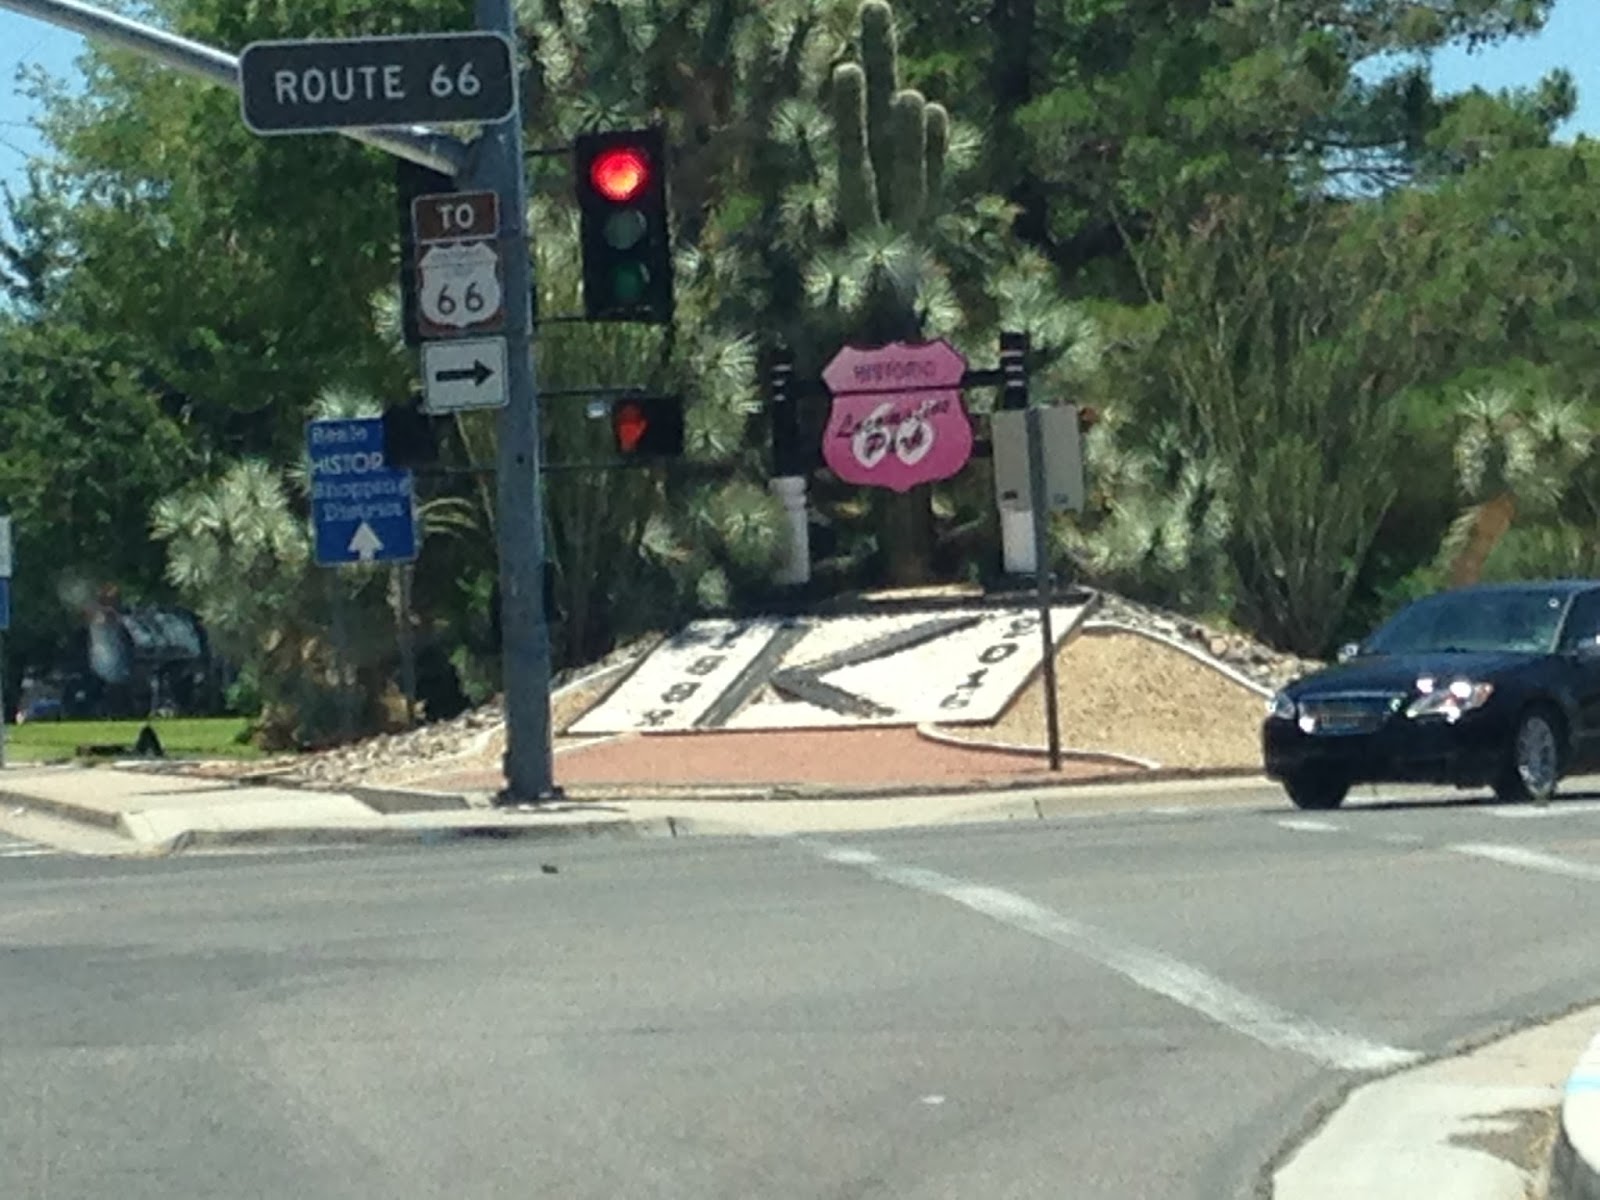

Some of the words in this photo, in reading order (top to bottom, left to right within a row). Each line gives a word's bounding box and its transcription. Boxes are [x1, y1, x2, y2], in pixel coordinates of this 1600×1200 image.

[274, 65, 405, 103] ROUTE
[430, 63, 481, 97] 66
[436, 203, 475, 230] TO
[437, 281, 484, 315] 66
[313, 451, 384, 475] HISTOR
